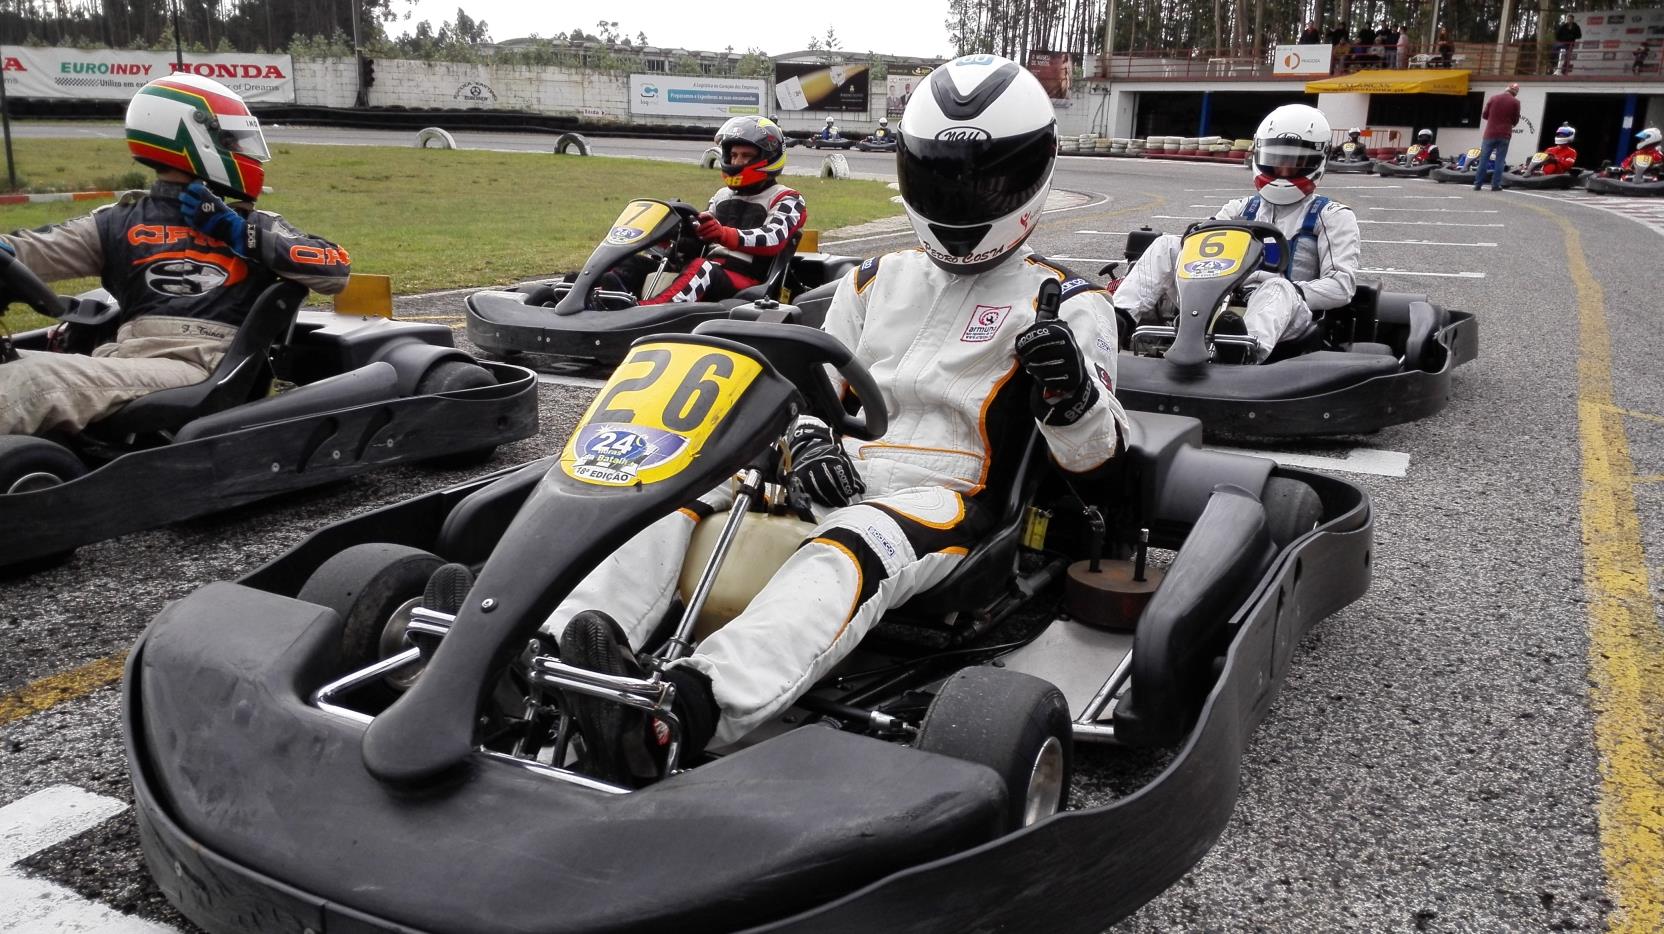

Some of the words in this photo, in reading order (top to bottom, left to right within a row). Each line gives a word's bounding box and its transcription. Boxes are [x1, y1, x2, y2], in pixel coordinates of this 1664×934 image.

[168, 63, 286, 79] HONDA
[624, 203, 654, 225] 7
[923, 240, 958, 264] PEDRO
[961, 245, 1005, 264] COSTA
[1199, 231, 1227, 258] 6
[589, 349, 734, 432] 26
[593, 431, 636, 453] 24
[590, 470, 629, 482] EDIÇÃO
